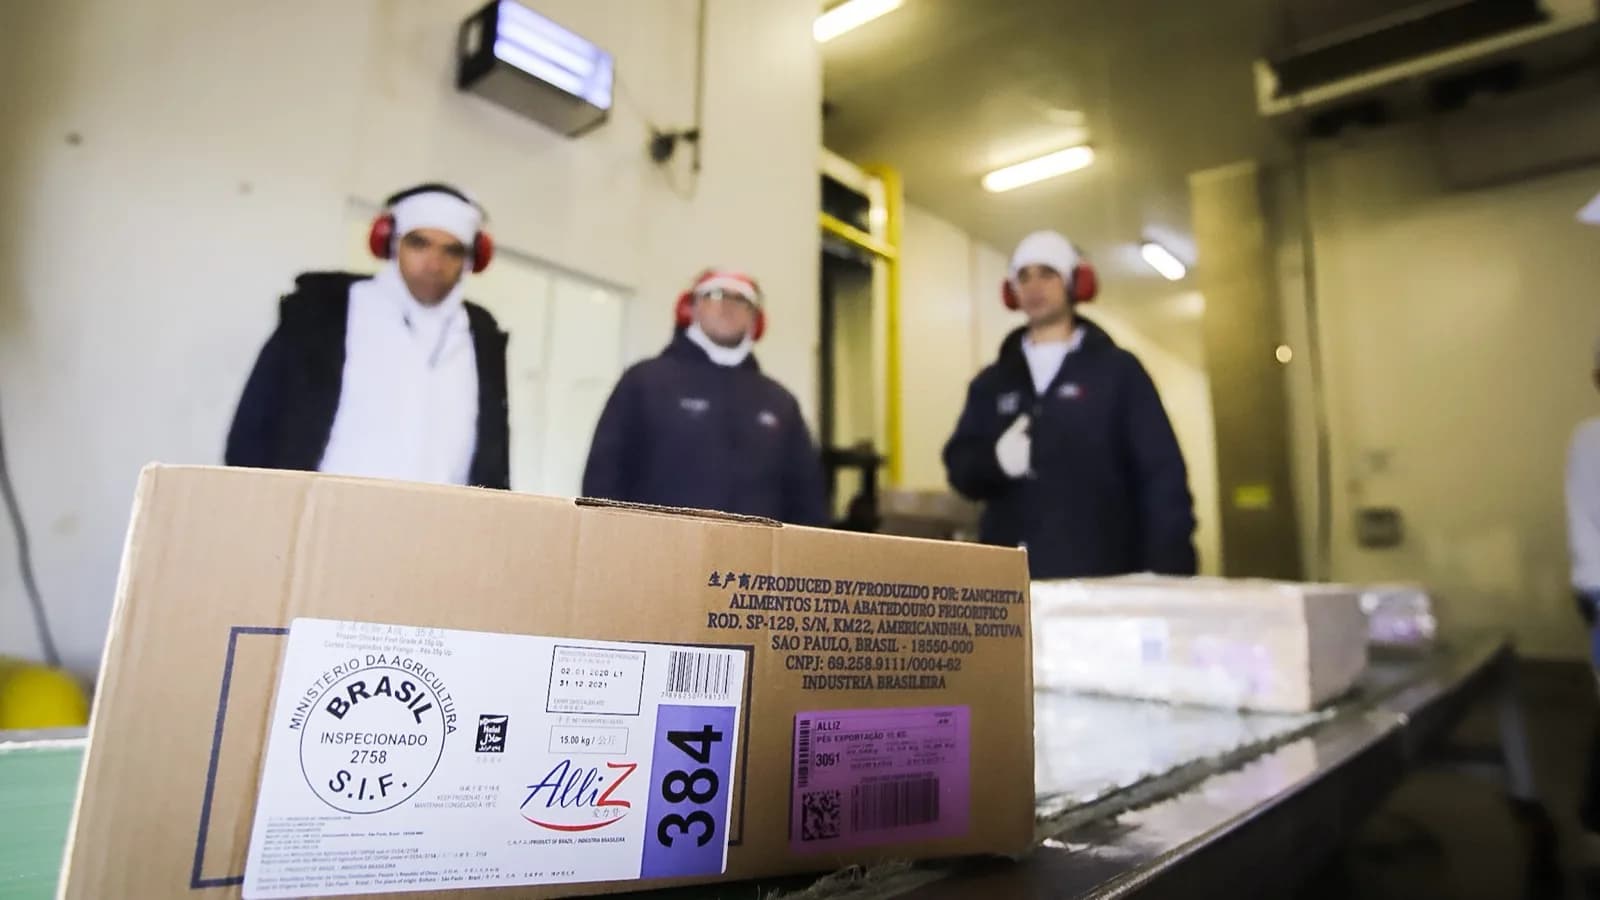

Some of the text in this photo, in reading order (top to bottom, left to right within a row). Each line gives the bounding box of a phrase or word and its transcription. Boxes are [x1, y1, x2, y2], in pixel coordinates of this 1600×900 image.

[835, 580, 930, 599] BY/PRODUZIDO
[932, 586, 959, 600] POR:
[961, 588, 1025, 604] ZANCHETTA
[729, 593, 1009, 620] ALIMENTOS LTDA ABATEDOURO FRIGORIFICO
[707, 612, 1023, 638] ROD. SP-129, S/N, KM22, AMERICANINHA, BOITUVA
[771, 635, 800, 650] SAO
[804, 636, 852, 652] PAULO,
[856, 638, 899, 653] BRASIL
[911, 639, 974, 654] 18550-000
[785, 655, 824, 670] CNPJ:
[802, 675, 946, 690] INDUSTRIA BRASILEIRA
[326, 675, 433, 725] BRASIL
[366, 654, 388, 666] DA
[390, 655, 457, 735] AGRICULTURA
[817, 720, 841, 731] ALLIZ
[320, 732, 428, 746] INSPECIONADO
[560, 735, 580, 745] 15.00
[350, 750, 388, 764] 2758
[815, 752, 841, 768] 3091
[328, 769, 408, 801] S.I.F.
[657, 725, 723, 848] 384
